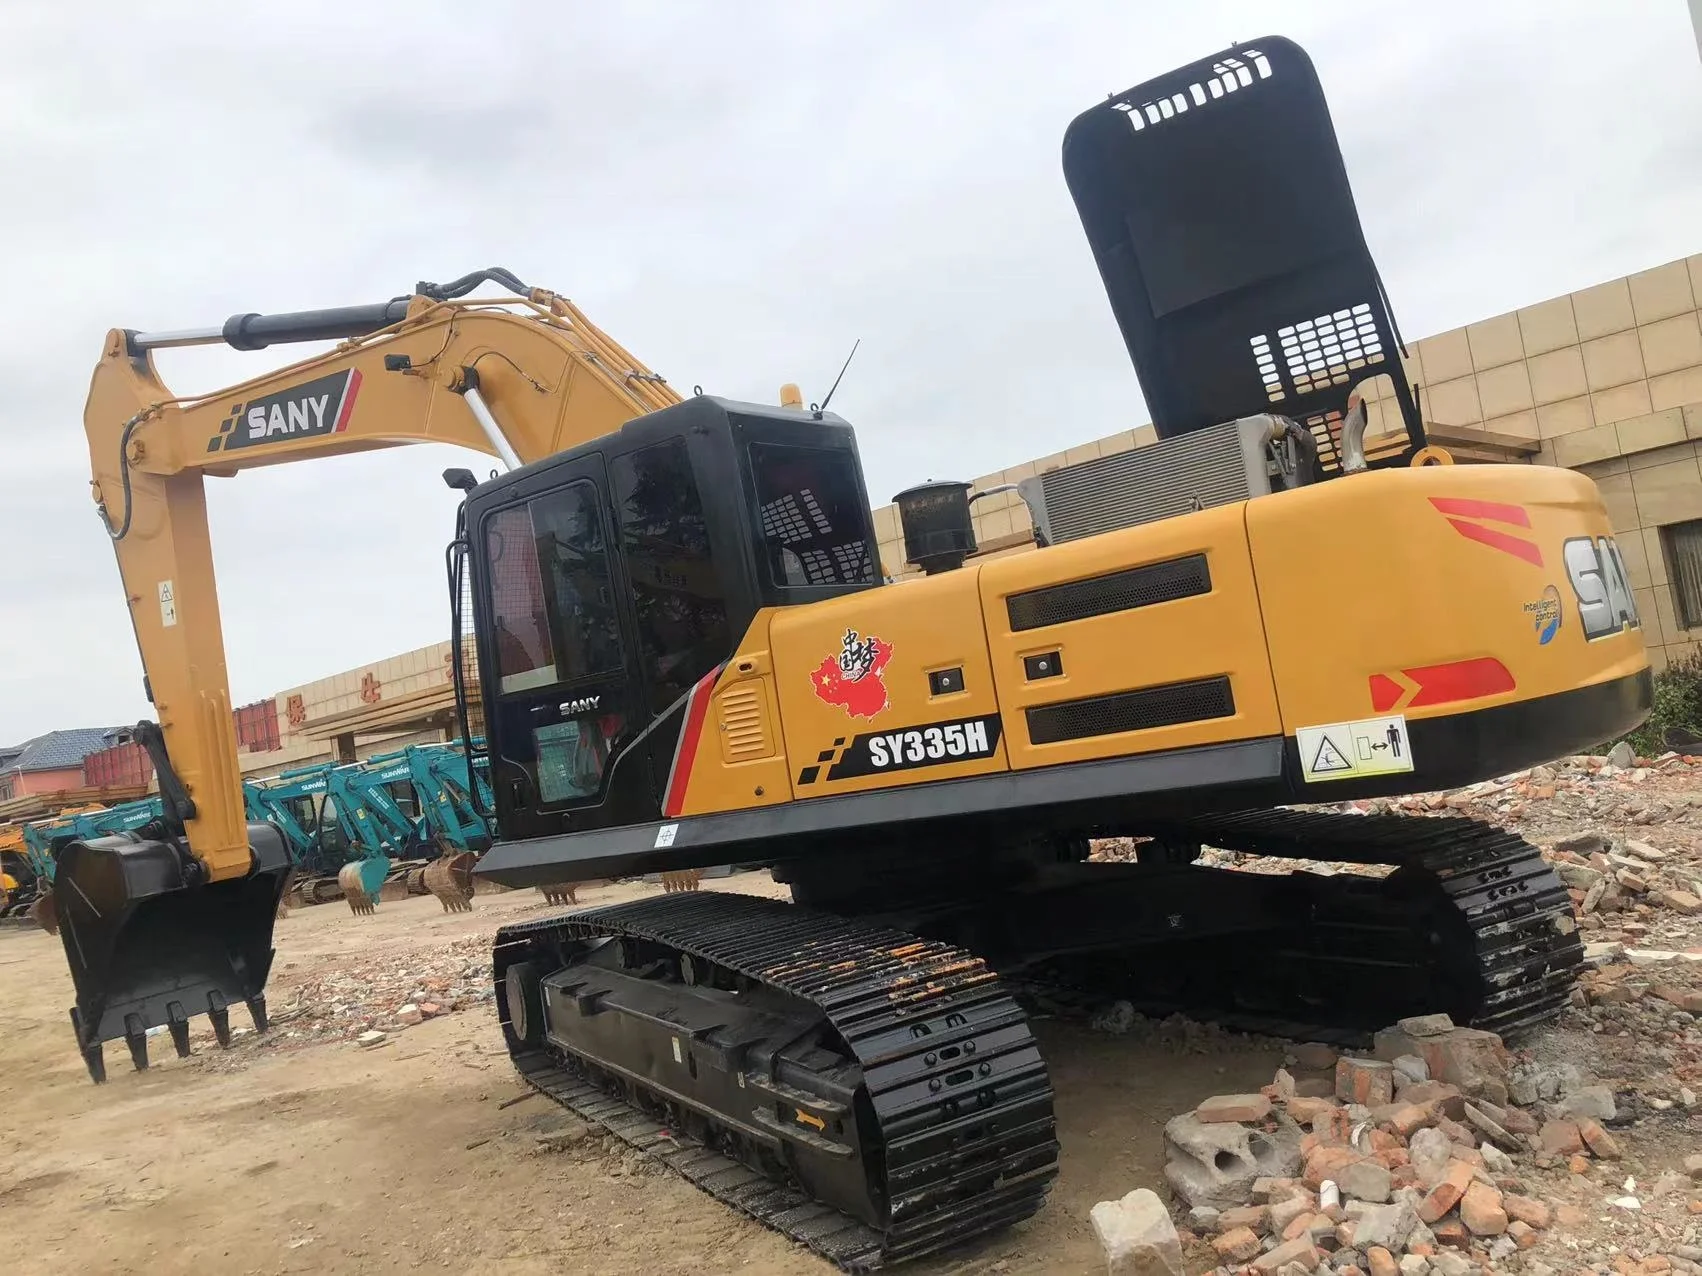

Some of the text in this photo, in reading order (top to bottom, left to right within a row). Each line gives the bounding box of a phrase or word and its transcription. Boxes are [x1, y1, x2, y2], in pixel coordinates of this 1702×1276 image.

[247, 394, 329, 439] SANY
[1523, 599, 1557, 612] Intelligent
[1563, 536, 1640, 643] SA
[839, 628, 880, 682] 中国梦
[559, 695, 600, 716] SANY
[867, 720, 989, 767] SY335H
